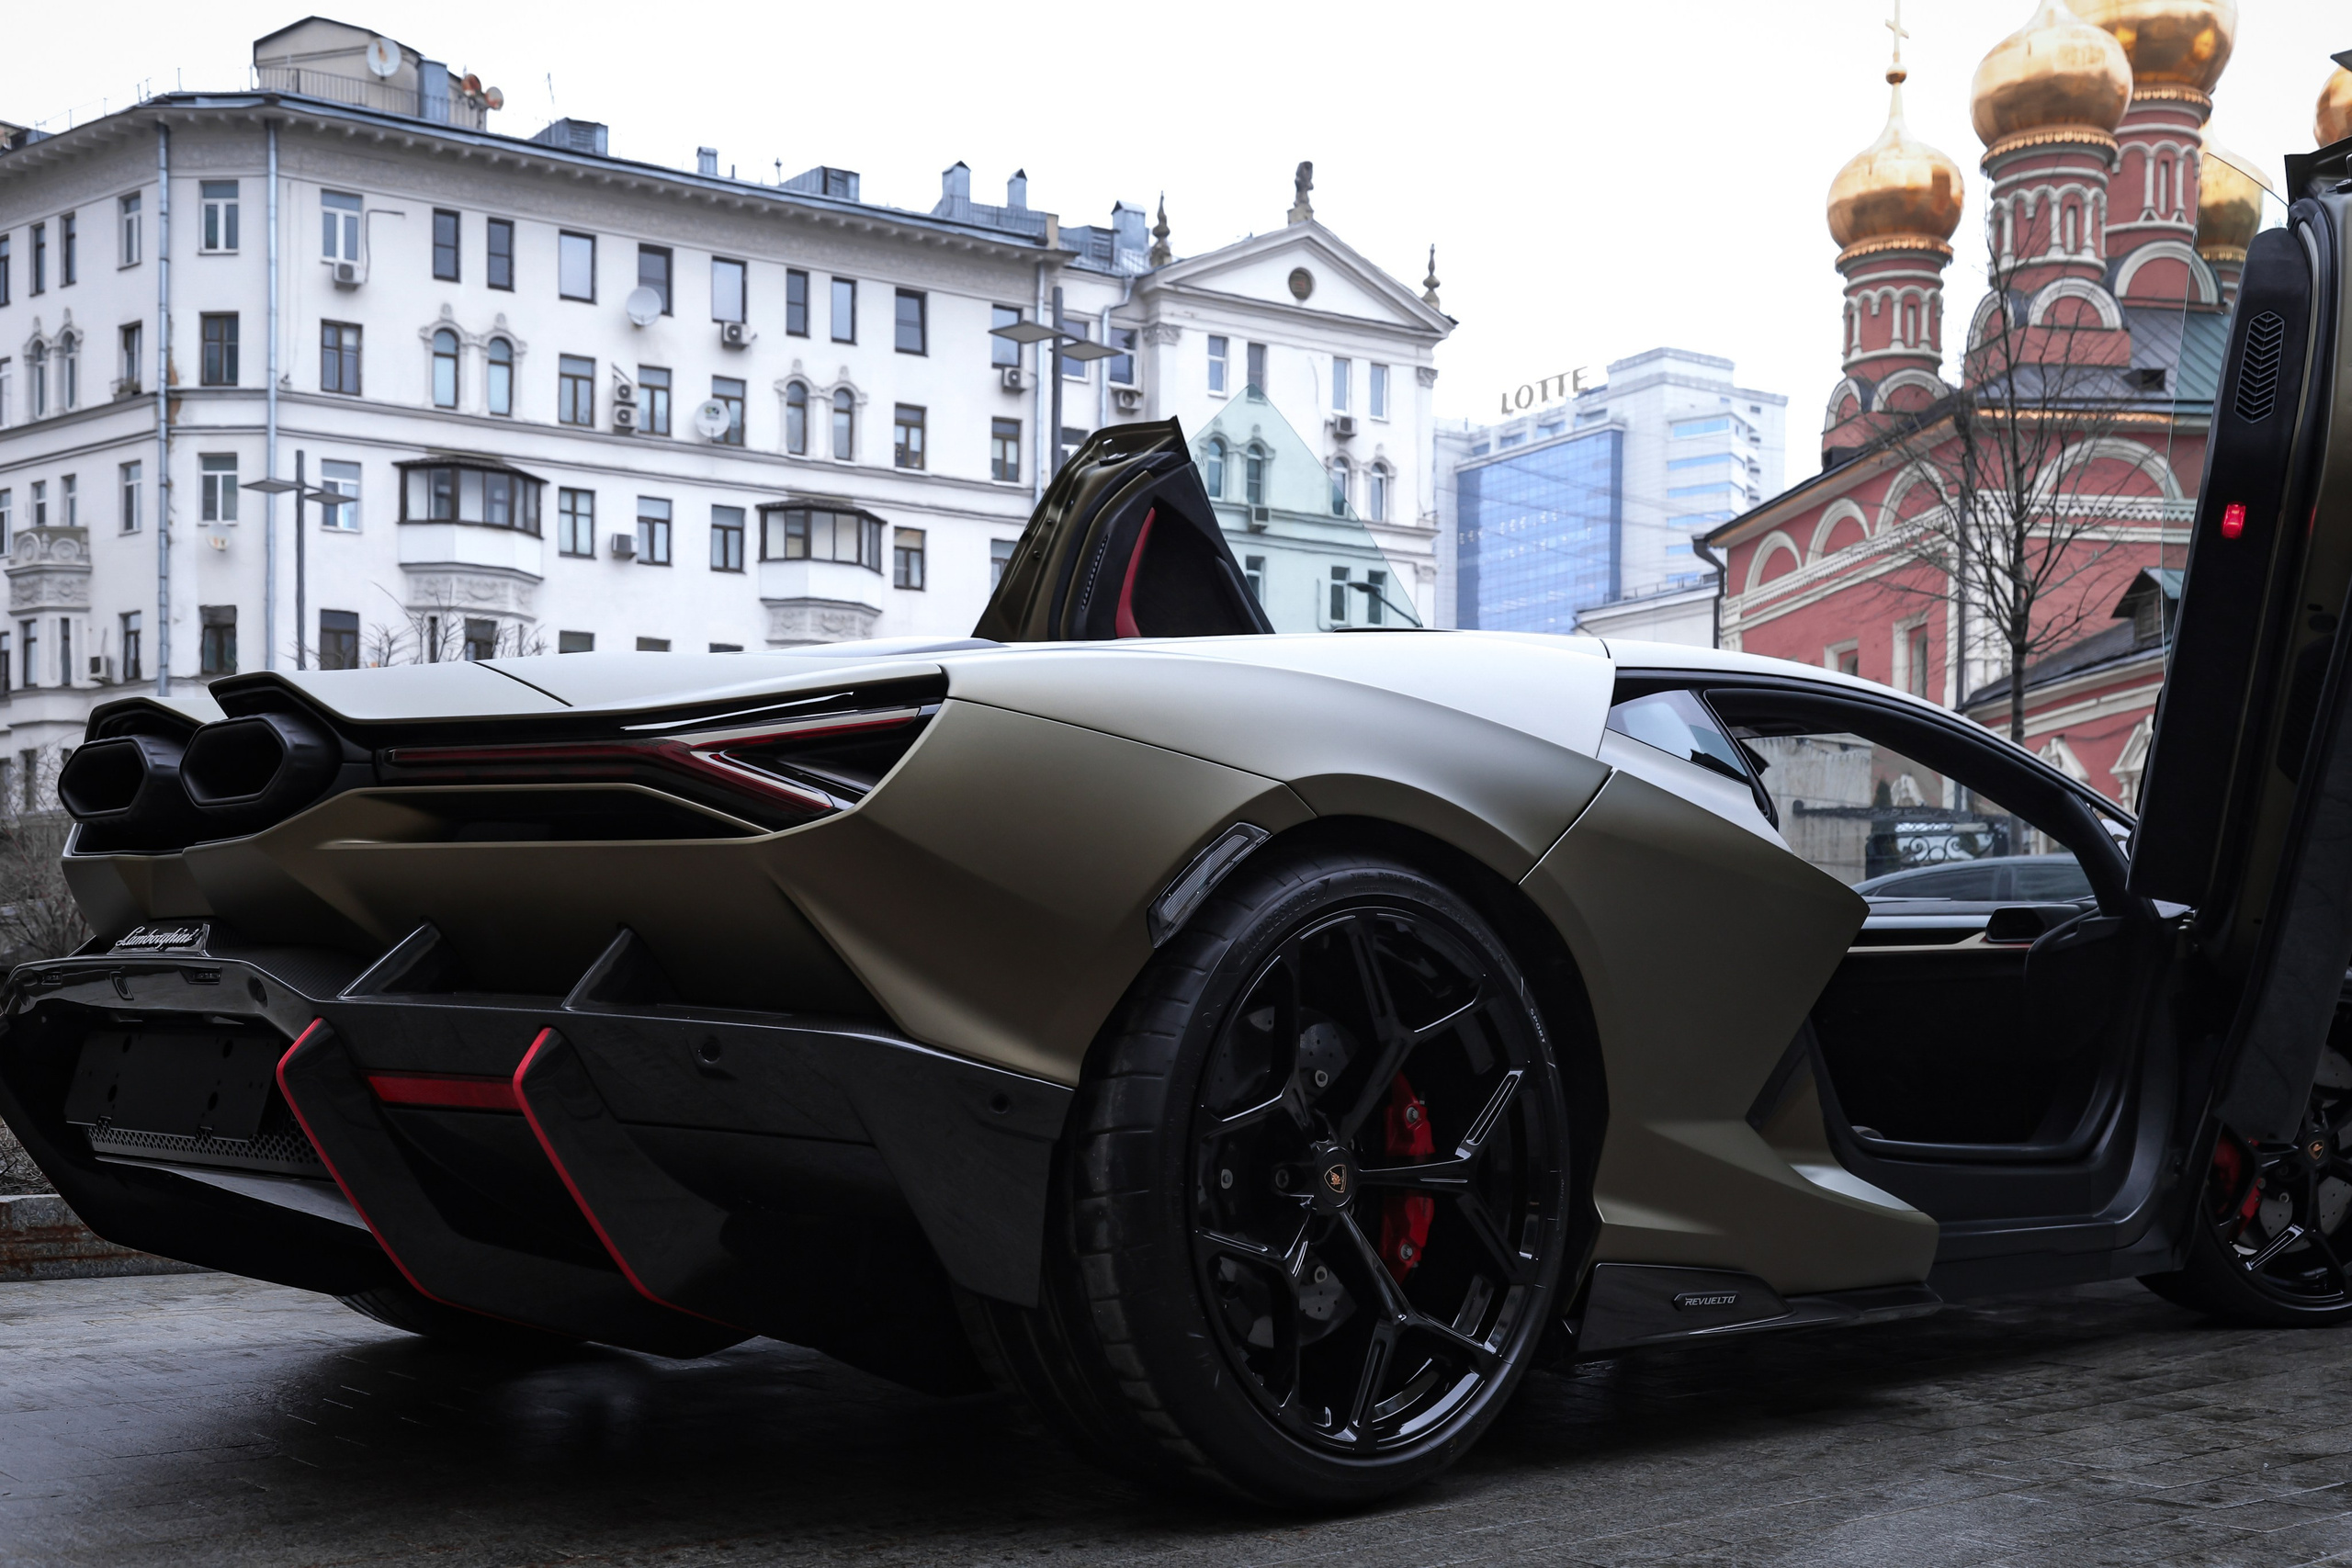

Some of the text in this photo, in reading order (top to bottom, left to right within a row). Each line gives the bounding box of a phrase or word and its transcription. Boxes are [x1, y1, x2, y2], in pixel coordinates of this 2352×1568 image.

[1501, 367, 1589, 414] LOTTE
[115, 925, 200, 950] Lamborghini
[1684, 1294, 1736, 1306] REVUELTO
